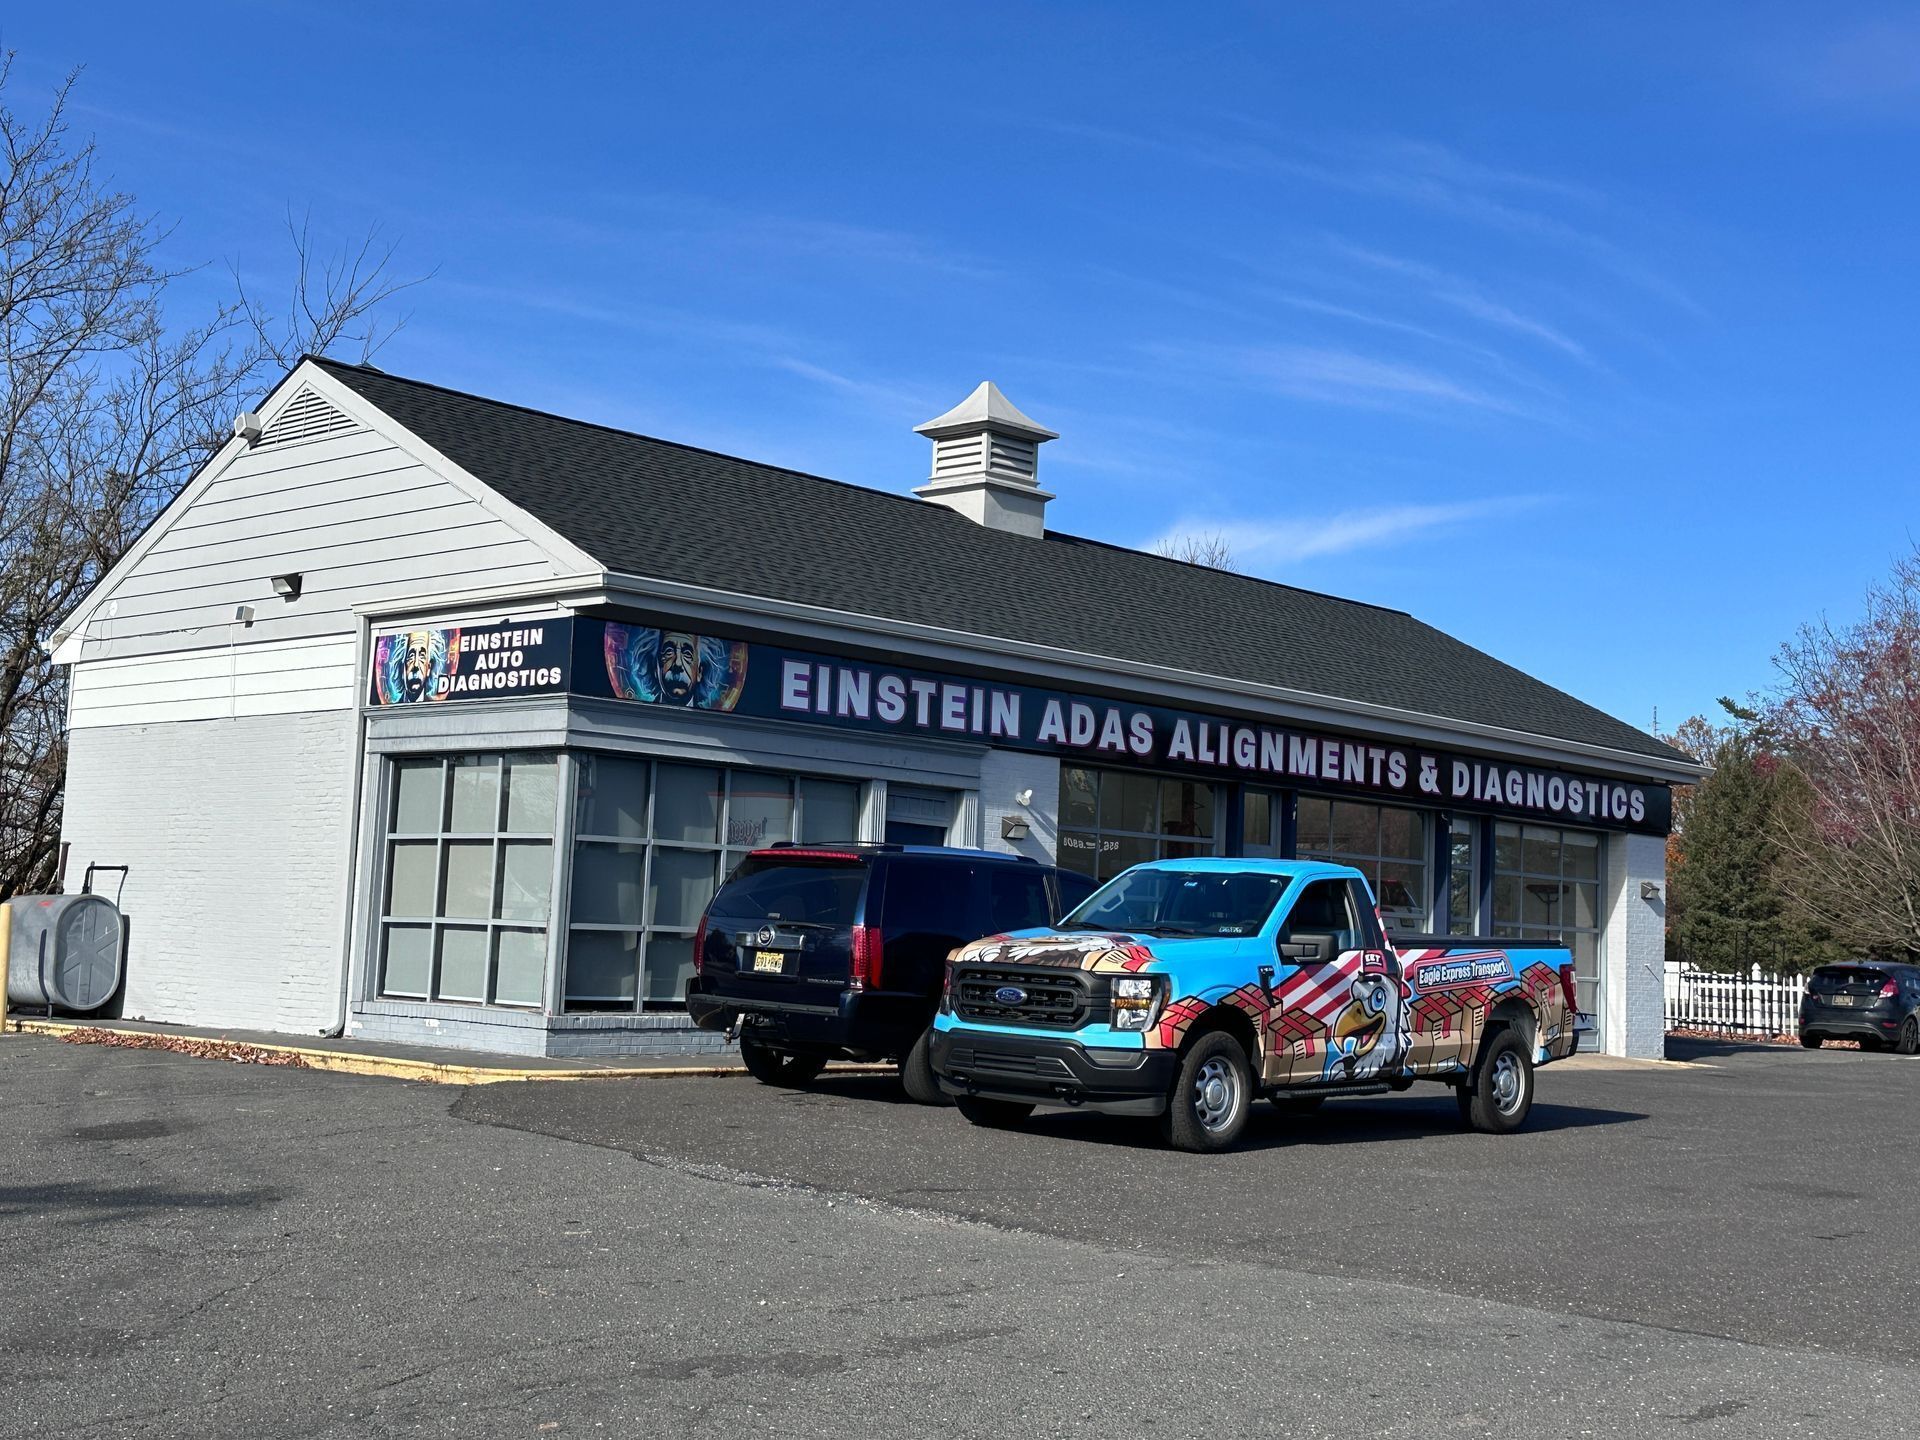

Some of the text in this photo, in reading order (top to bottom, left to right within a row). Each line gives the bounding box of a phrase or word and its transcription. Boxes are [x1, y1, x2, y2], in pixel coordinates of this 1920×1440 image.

[459, 627, 544, 652] EINSTEIN
[474, 650, 524, 671] AUTO
[437, 667, 562, 694] DIAGNOSTICS
[780, 658, 1646, 823] EINSTEIN ADAS ALIGNMENTS & DIAGNOSTICS
[1419, 959, 1507, 985] Eagle Express Transport
